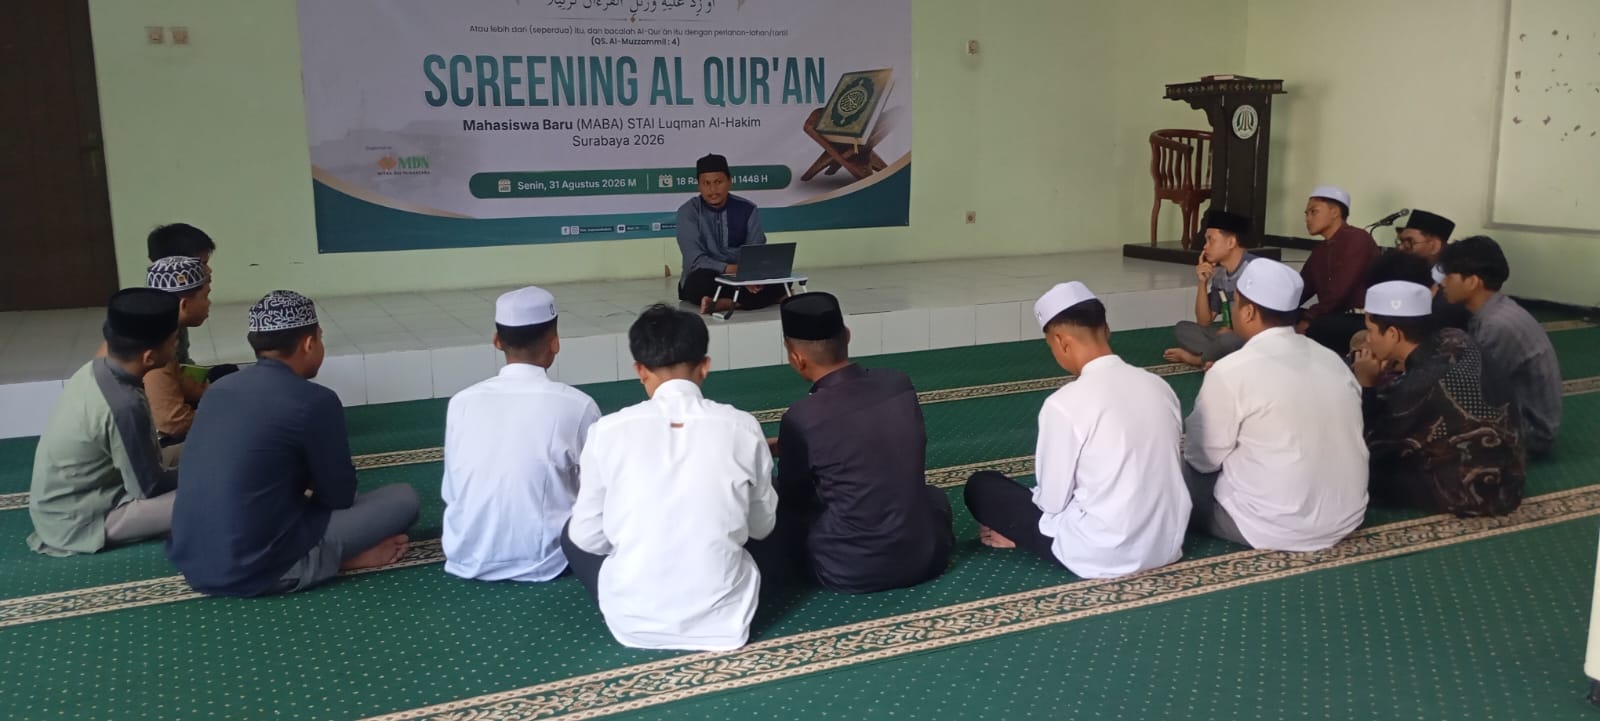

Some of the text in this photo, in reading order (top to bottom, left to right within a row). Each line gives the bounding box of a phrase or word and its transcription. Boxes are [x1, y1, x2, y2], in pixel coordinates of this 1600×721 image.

[469, 25, 489, 33] Atau
[490, 25, 510, 33] lebih
[511, 25, 527, 33] dari
[587, 27, 602, 35] dan
[684, 29, 713, 38] dengan
[591, 37, 609, 46] (QS.
[423, 54, 638, 107] SCREENING
[649, 56, 694, 106] AL
[703, 56, 826, 108] QUR'AN
[463, 116, 761, 132] Mahasiswa Baru (MABA) STAI Luqman Al-Hakim
[572, 134, 665, 148] Surabaya 2026
[517, 178, 637, 191] Senin, 31 Agustus 2026 M
[676, 177, 686, 186] 18
[738, 174, 759, 183] 1448
[760, 174, 768, 183] H
